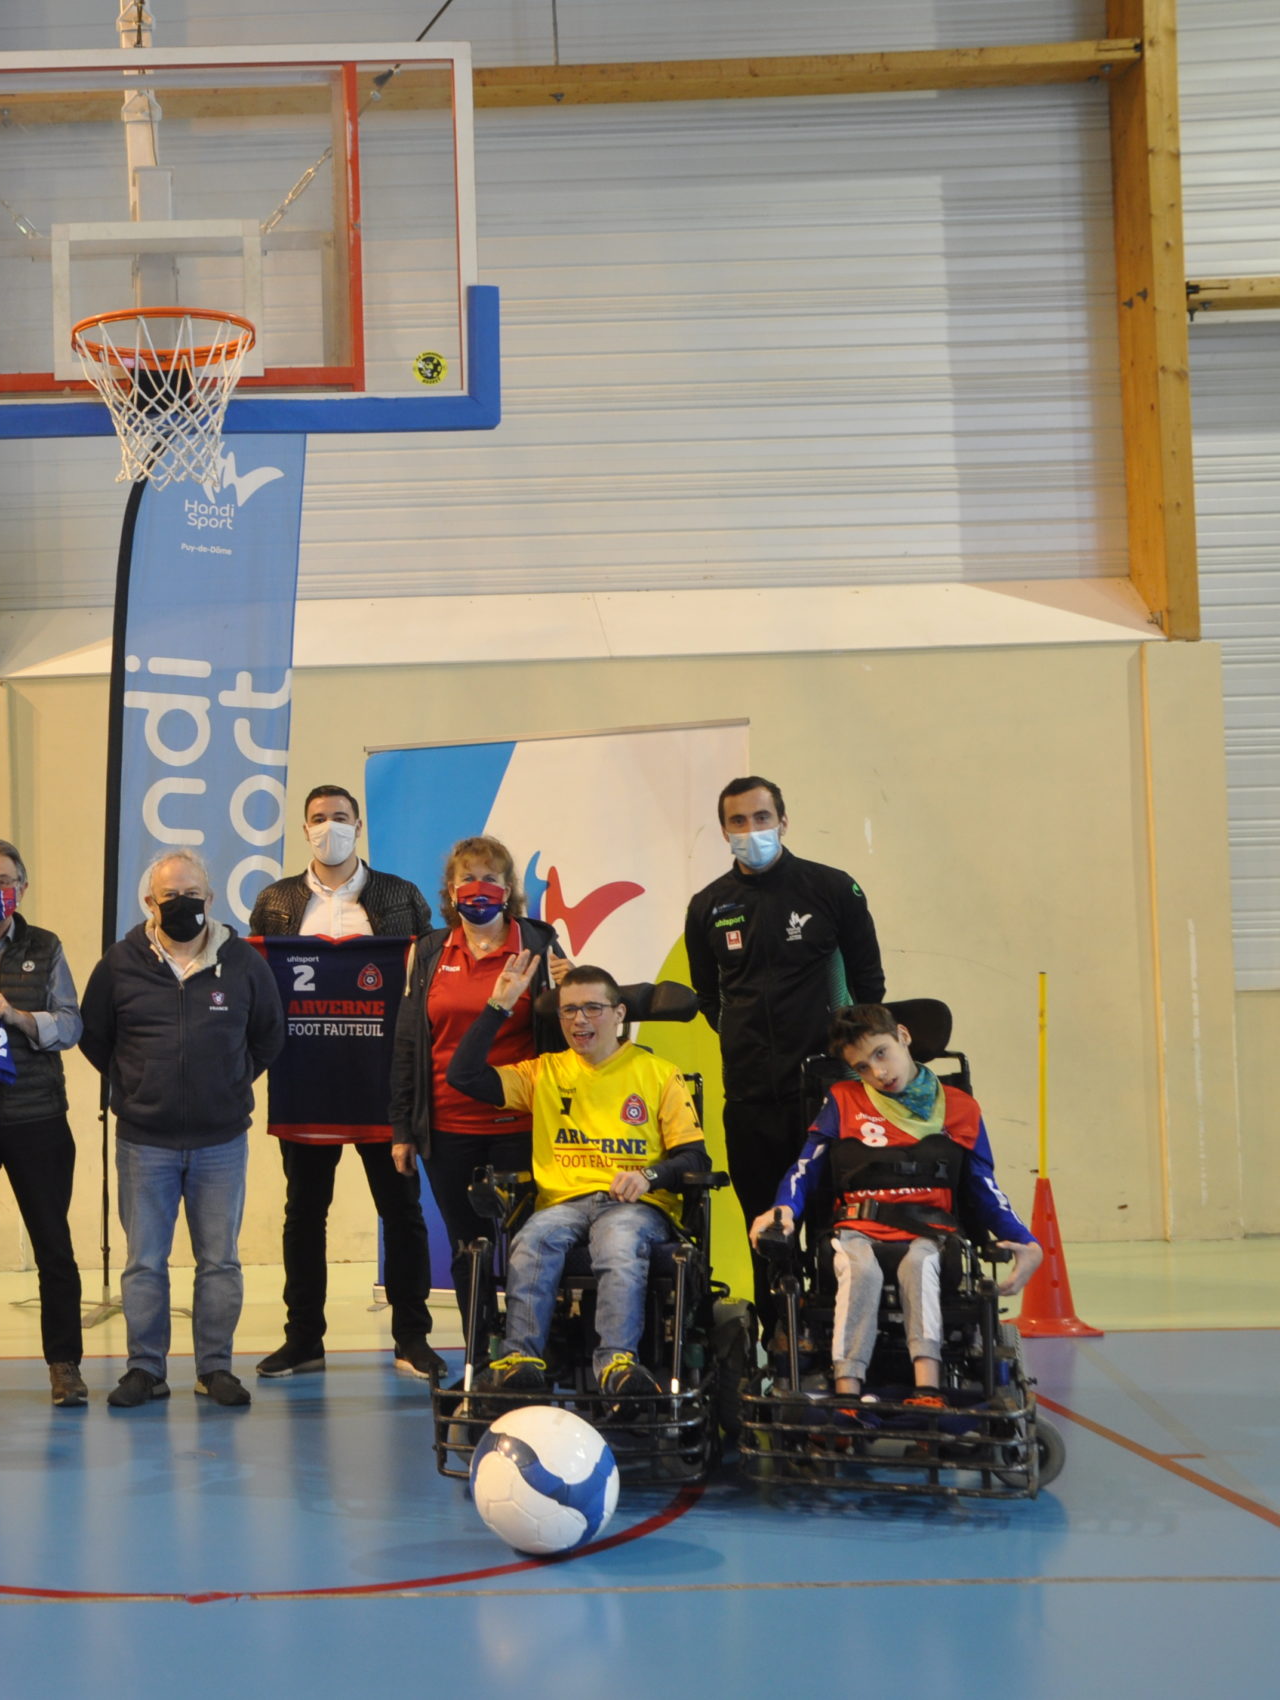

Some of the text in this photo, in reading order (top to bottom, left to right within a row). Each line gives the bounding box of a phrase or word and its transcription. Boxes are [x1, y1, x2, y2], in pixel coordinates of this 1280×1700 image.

[184, 499, 235, 517] Handi
[186, 512, 233, 530] Sport
[124, 655, 212, 900] ndi
[293, 965, 316, 991] 2
[288, 1000, 385, 1015] ARVERNE
[288, 1023, 385, 1037] FOOT FAUTEUIL
[855, 1112, 887, 1122] uhlspor
[555, 1128, 647, 1155] ARVRNE
[860, 1122, 888, 1148] 8
